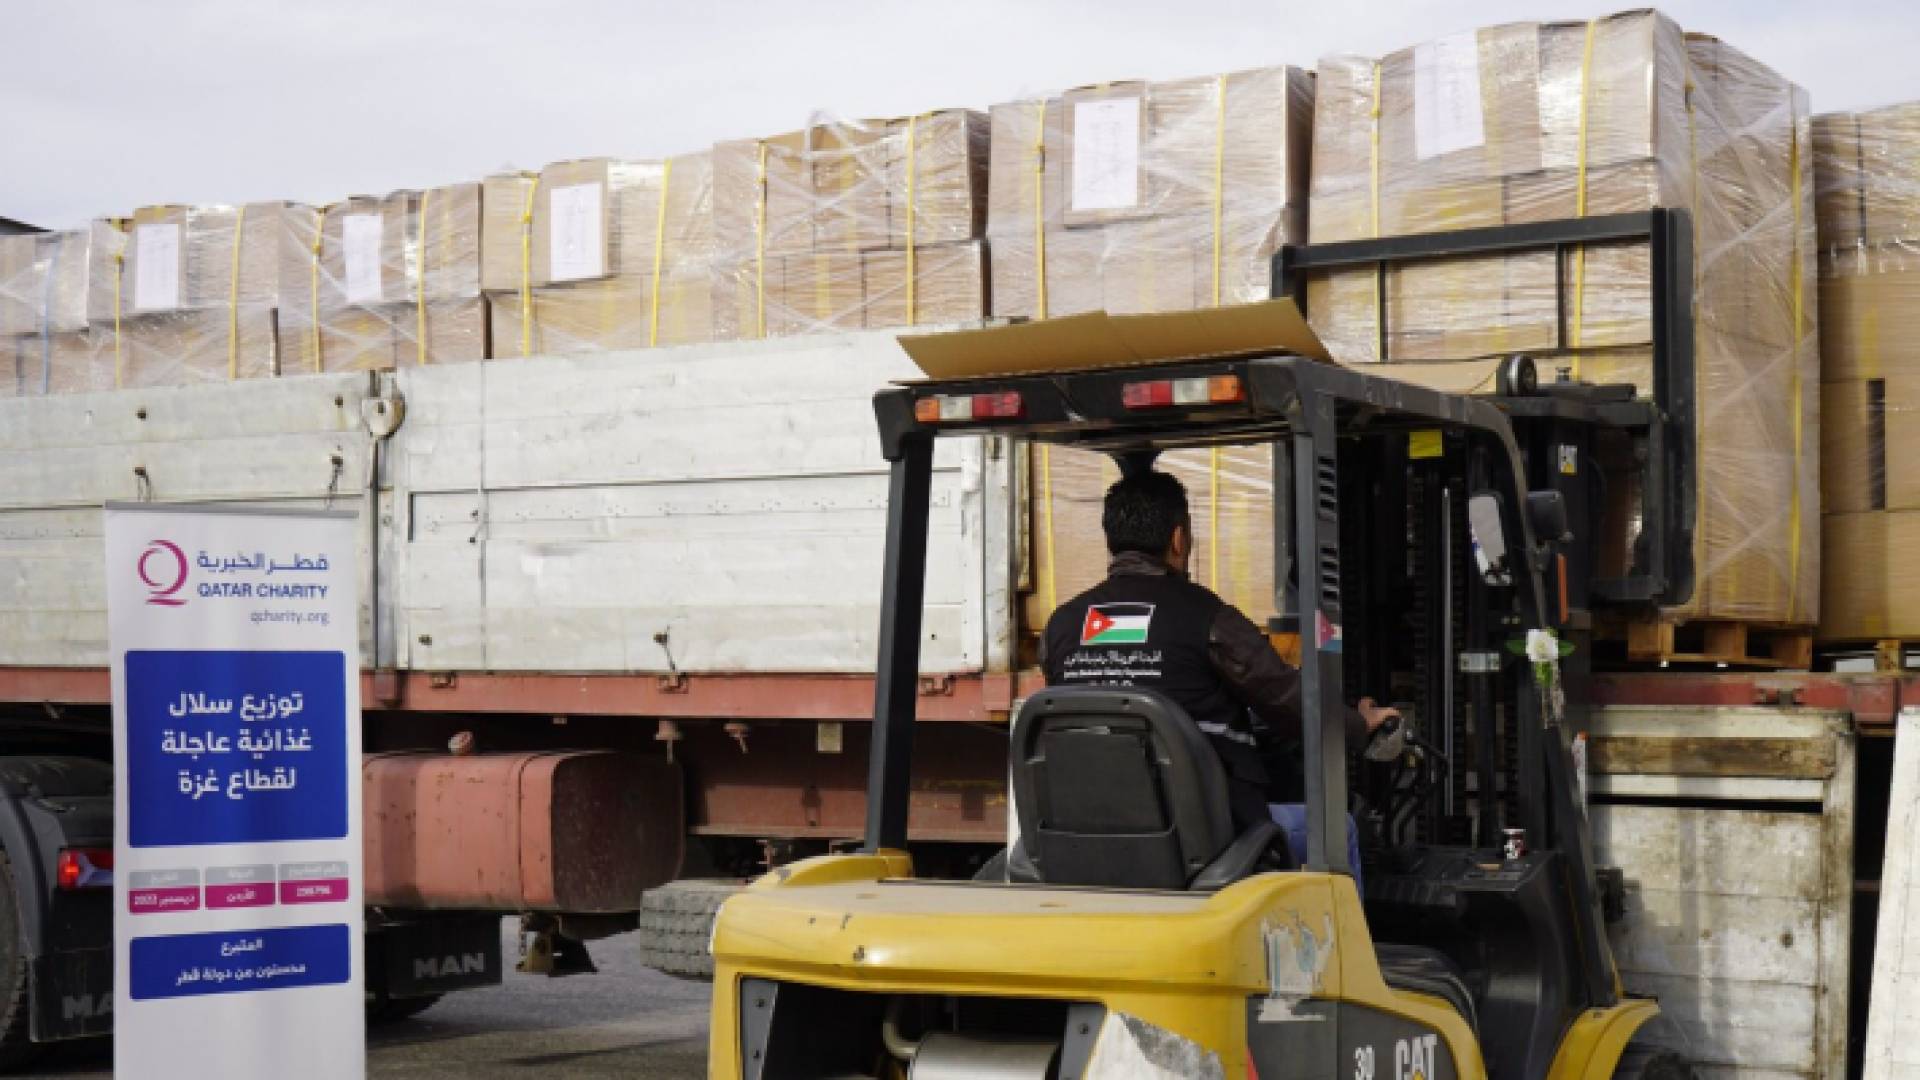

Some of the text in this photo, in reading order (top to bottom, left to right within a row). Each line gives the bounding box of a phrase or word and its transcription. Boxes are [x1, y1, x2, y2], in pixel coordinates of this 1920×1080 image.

[197, 551, 329, 575] قطر الخيرية
[197, 583, 329, 599] QATAR CHARITY
[250, 609, 330, 625] qcharity.org
[169, 691, 303, 721] توزيع سلال
[161, 728, 313, 760] غذائية عاجلة
[177, 767, 298, 801] لقطاع غزة
[414, 953, 486, 979] MAN
[1396, 1034, 1437, 1080] CAT
